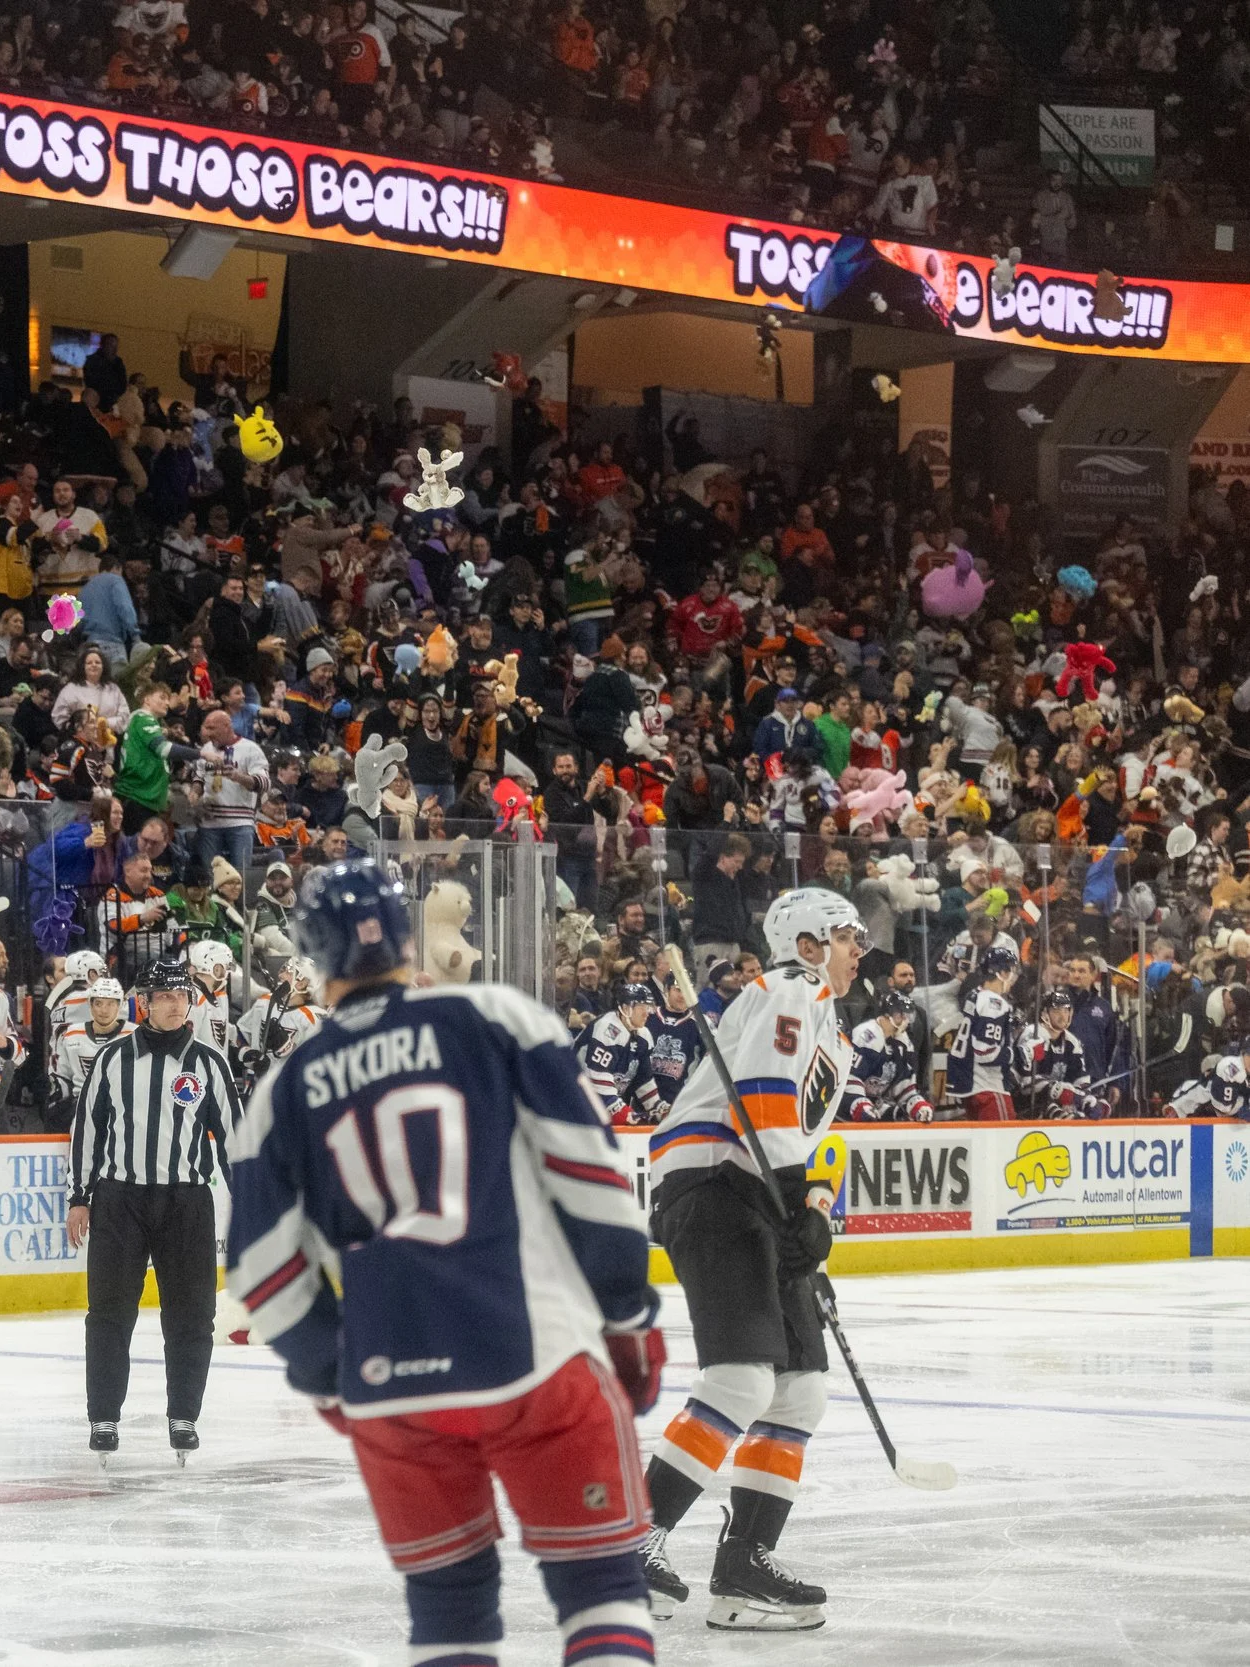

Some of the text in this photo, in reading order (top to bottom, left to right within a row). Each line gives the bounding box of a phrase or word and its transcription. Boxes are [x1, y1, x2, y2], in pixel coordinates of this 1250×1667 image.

[1110, 116, 1138, 129] ARE
[1085, 134, 1142, 149] PASSION
[1094, 428, 1151, 446] 107
[1188, 443, 1228, 457] AND
[1081, 469, 1110, 482] First
[1060, 480, 1166, 498] Commonwealth
[773, 1014, 802, 1057] 5
[985, 1023, 1003, 1041] 28
[591, 1046, 613, 1068] 58
[303, 1023, 443, 1110] SYKORA
[1223, 1086, 1233, 1102] 9
[325, 1083, 470, 1246] 10
[1082, 1138, 1184, 1180] nucar
[6, 1154, 68, 1188] THE
[850, 1146, 970, 1207] NEWS
[1082, 1187, 1183, 1203] Automall of Allentown
[4, 1227, 78, 1262] CALL
